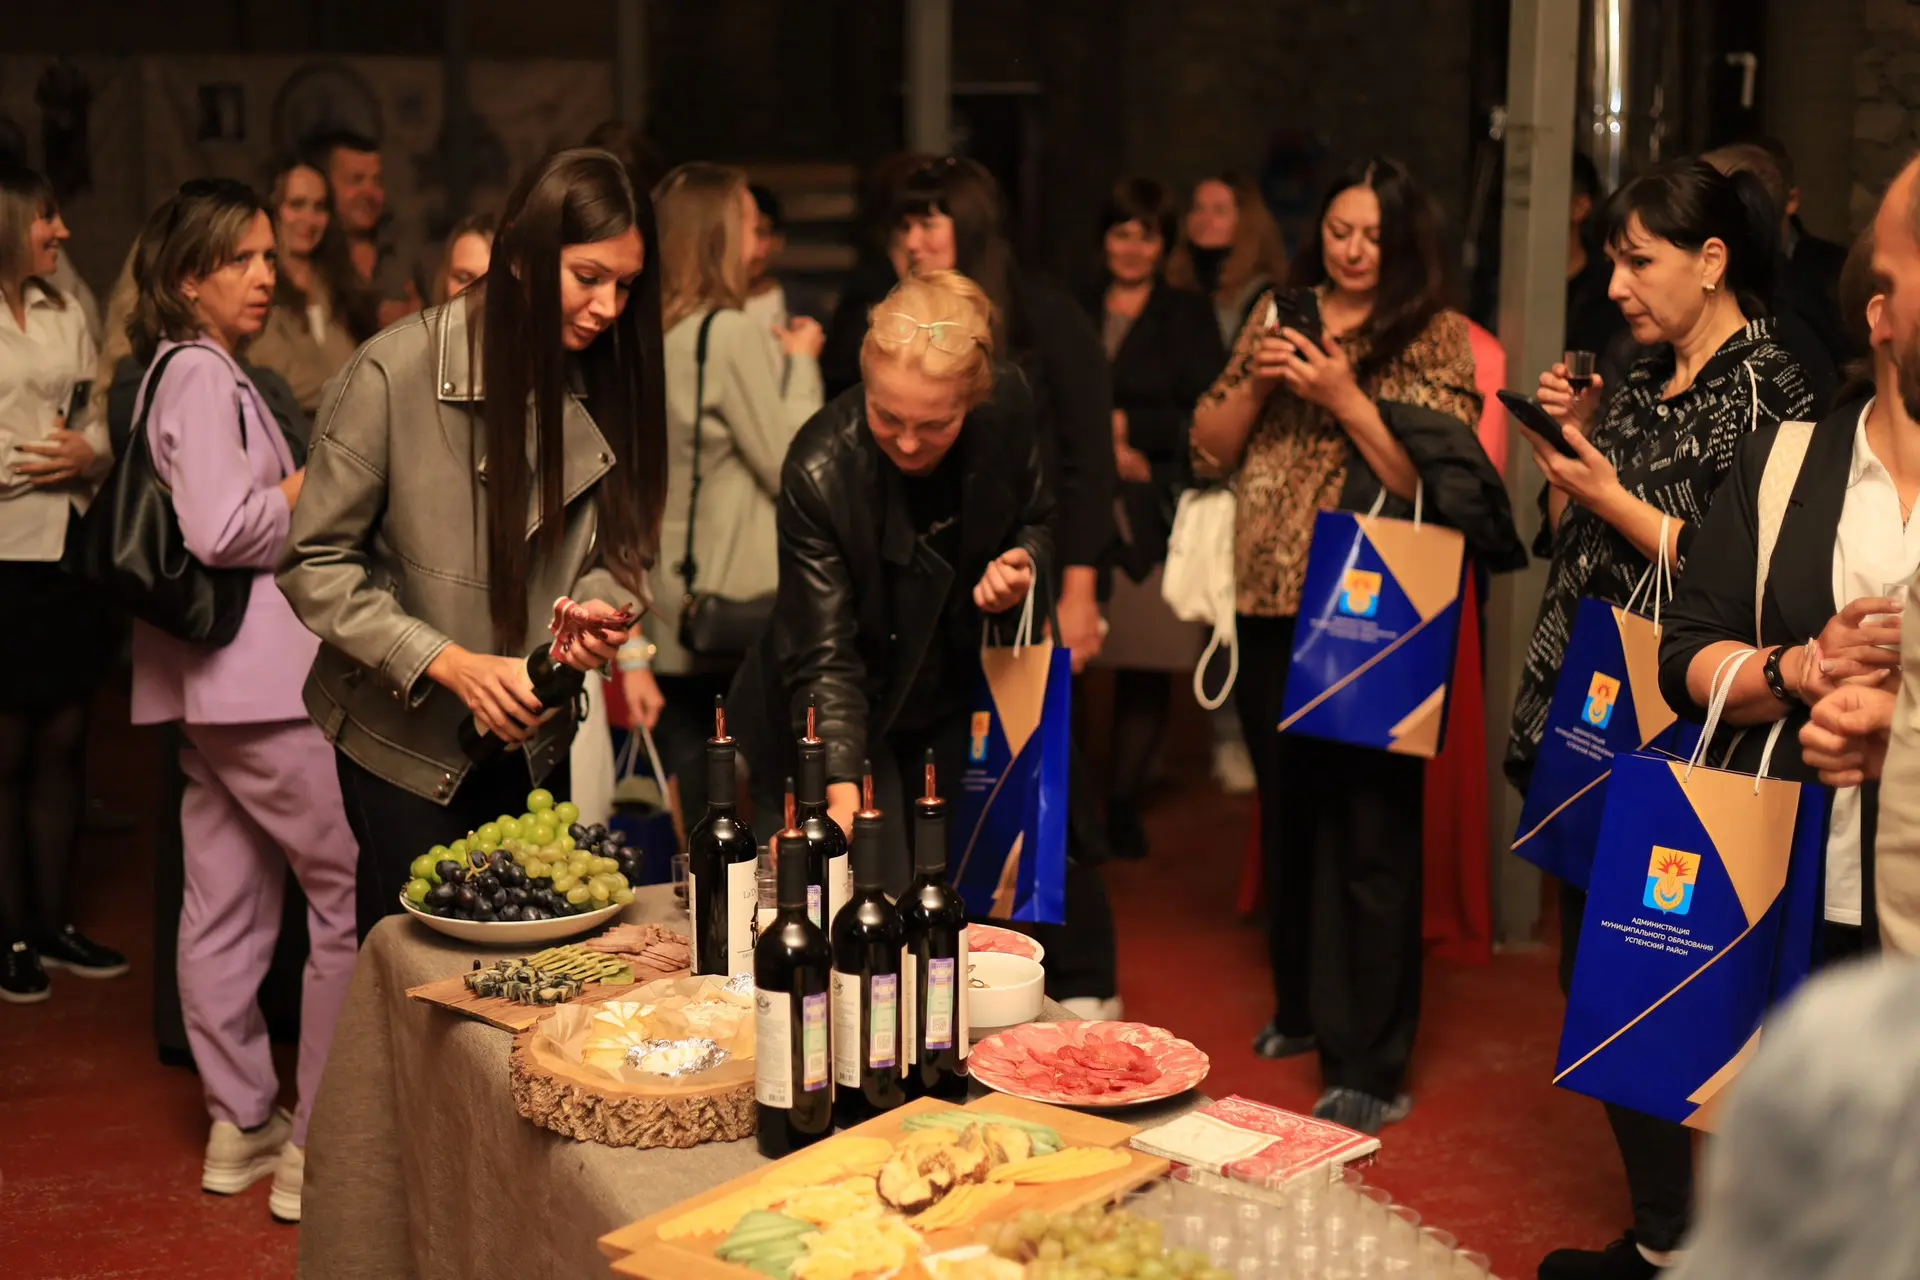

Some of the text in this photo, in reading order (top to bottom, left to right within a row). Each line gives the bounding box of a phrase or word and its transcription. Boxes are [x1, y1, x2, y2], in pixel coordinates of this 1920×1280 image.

[1601, 920, 1714, 951] МУНИЦИПАЛЬНОГО ОБРАЗОВАНИЯ
[1631, 917, 1690, 935] АДМИНИСТРАЦИЯ
[1624, 935, 1689, 956] УСПЕНСКИЙ РАЙОН
